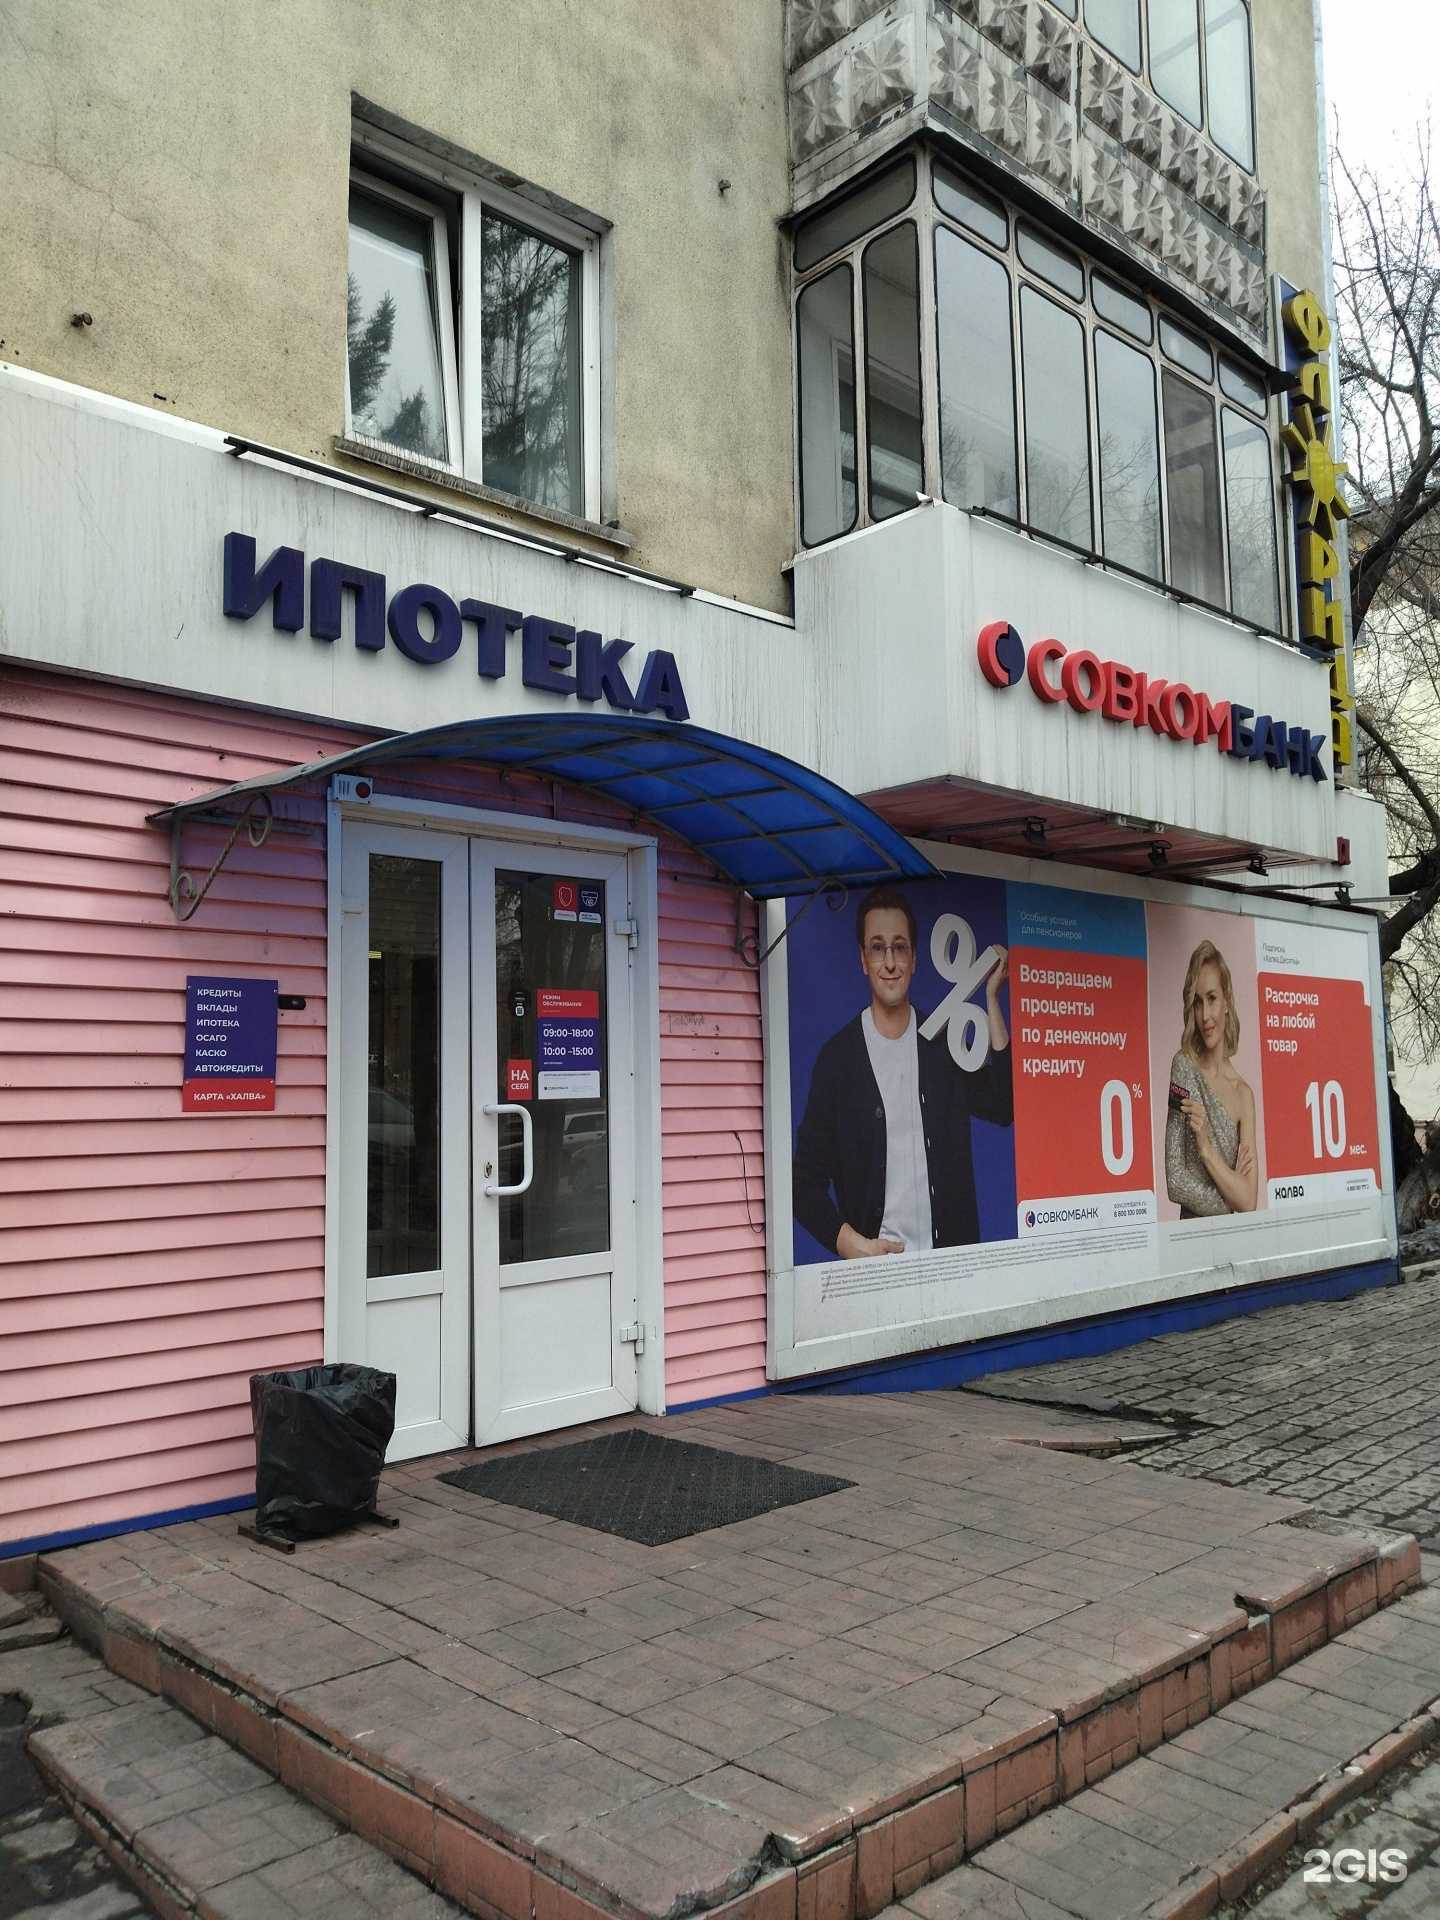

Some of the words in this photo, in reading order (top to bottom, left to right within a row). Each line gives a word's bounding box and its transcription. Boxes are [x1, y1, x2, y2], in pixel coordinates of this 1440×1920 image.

[223, 531, 690, 721] ИПОТЕКА
[1027, 638, 1328, 783] СОВКОМБАНК
[1019, 964, 1112, 990] Возвращаем
[197, 989, 242, 998] КРЕДИТЫ
[1265, 987, 1319, 1008] Рассрочка
[196, 1004, 238, 1013] ВКЛАДЫ
[1020, 998, 1095, 1017] проценты
[196, 1019, 240, 1027] ИПОТЕКА
[1266, 1015, 1280, 1028] на
[1281, 1012, 1316, 1029] любой
[195, 1034, 227, 1042] ОСАГО
[1022, 1028, 1041, 1043] по
[1044, 1029, 1127, 1050] денежному
[195, 1049, 227, 1057] КАСКО
[544, 1047, 566, 1055] 10:00
[1267, 1039, 1298, 1056] товар
[511, 1070, 529, 1081] НА
[1023, 1058, 1085, 1077] кредиту
[193, 1093, 224, 1101] КАРТА
[226, 1093, 266, 1101] «ХАЛВА»
[1305, 1080, 1346, 1159] 10
[1036, 1207, 1099, 1224] СОВКОМБАНК
